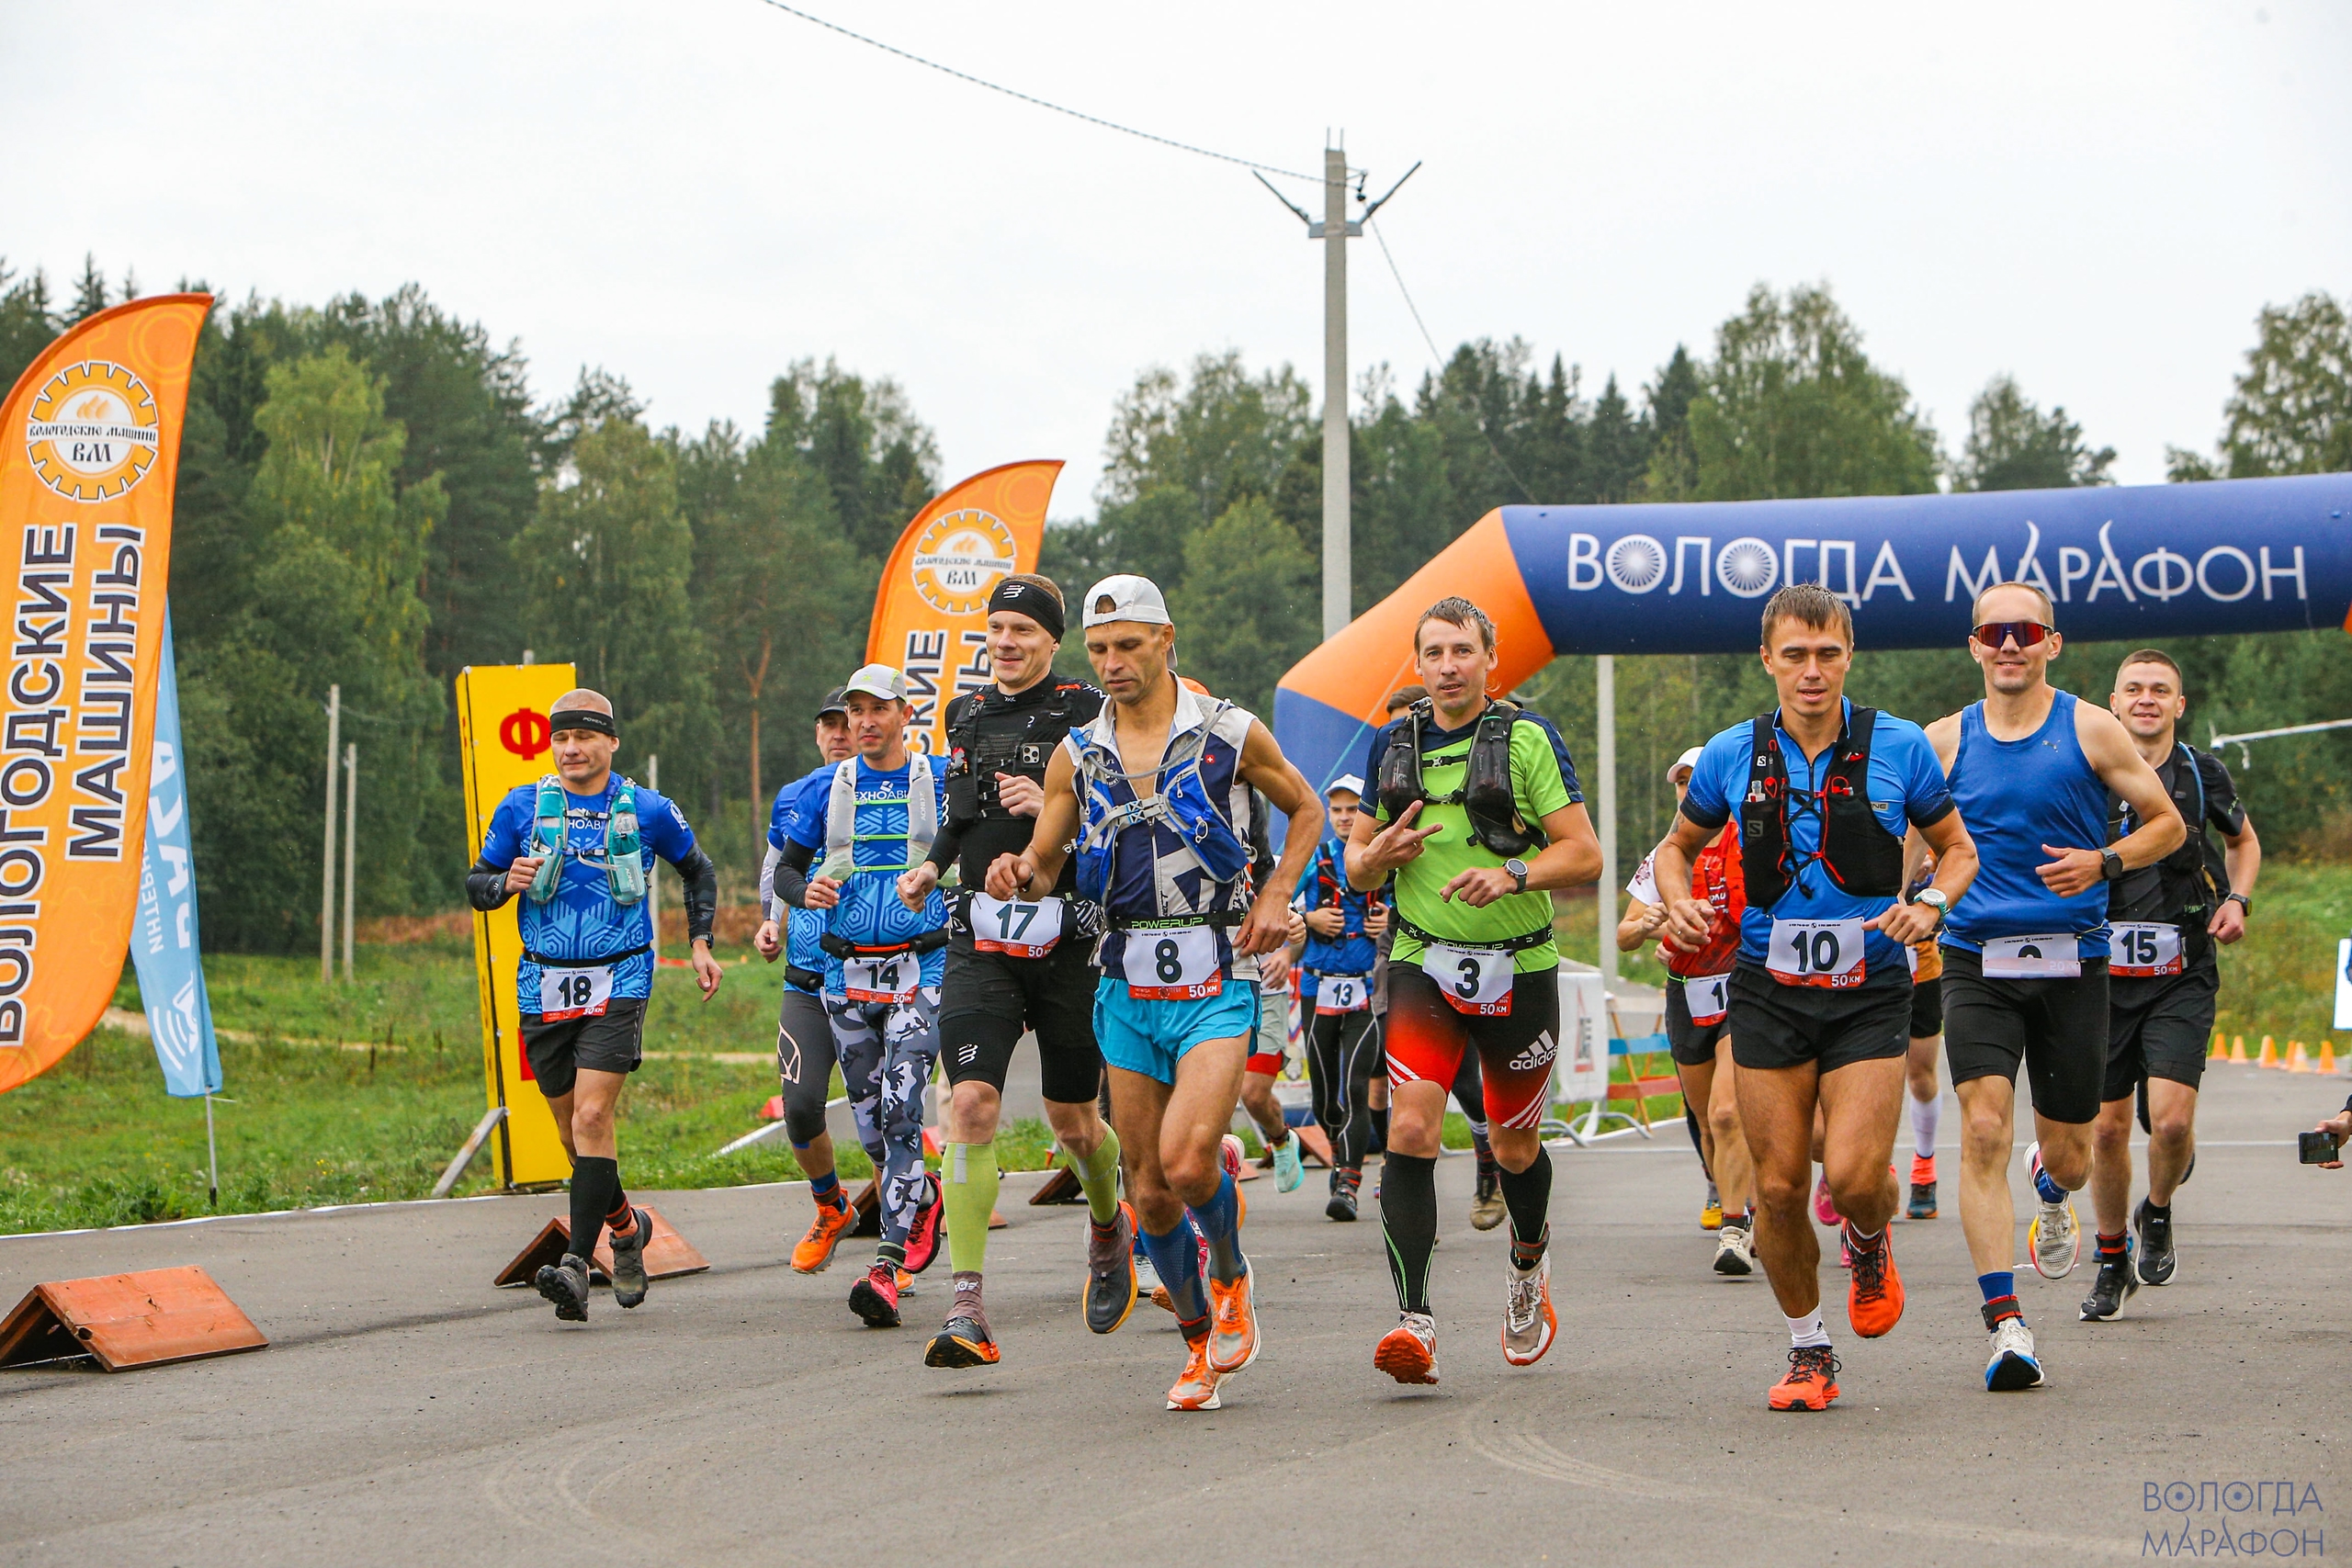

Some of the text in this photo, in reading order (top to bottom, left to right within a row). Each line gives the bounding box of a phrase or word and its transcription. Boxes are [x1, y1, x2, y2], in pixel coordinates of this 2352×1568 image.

[73, 442, 112, 462] ВМ
[1567, 520, 2307, 610] ВОЛОГДА МАРАФОН
[65, 524, 145, 861] МАШИНЫ
[996, 904, 1039, 940] 17
[1131, 917, 1203, 930] POWERUP
[1028, 946, 1043, 957] 50
[1791, 931, 1839, 972] 10
[2120, 931, 2157, 964] 15
[1155, 939, 1182, 984] 8
[2154, 966, 2167, 975] 50
[865, 964, 899, 990] 14
[1455, 957, 1480, 998] 3
[1831, 975, 1848, 987] 50
[558, 976, 592, 1008] 18
[893, 994, 904, 1003] 50
[1188, 985, 1205, 998] 50
[1332, 983, 1352, 1006] 13
[1480, 1004, 1495, 1014] 50
[1510, 1045, 1557, 1070] adidas
